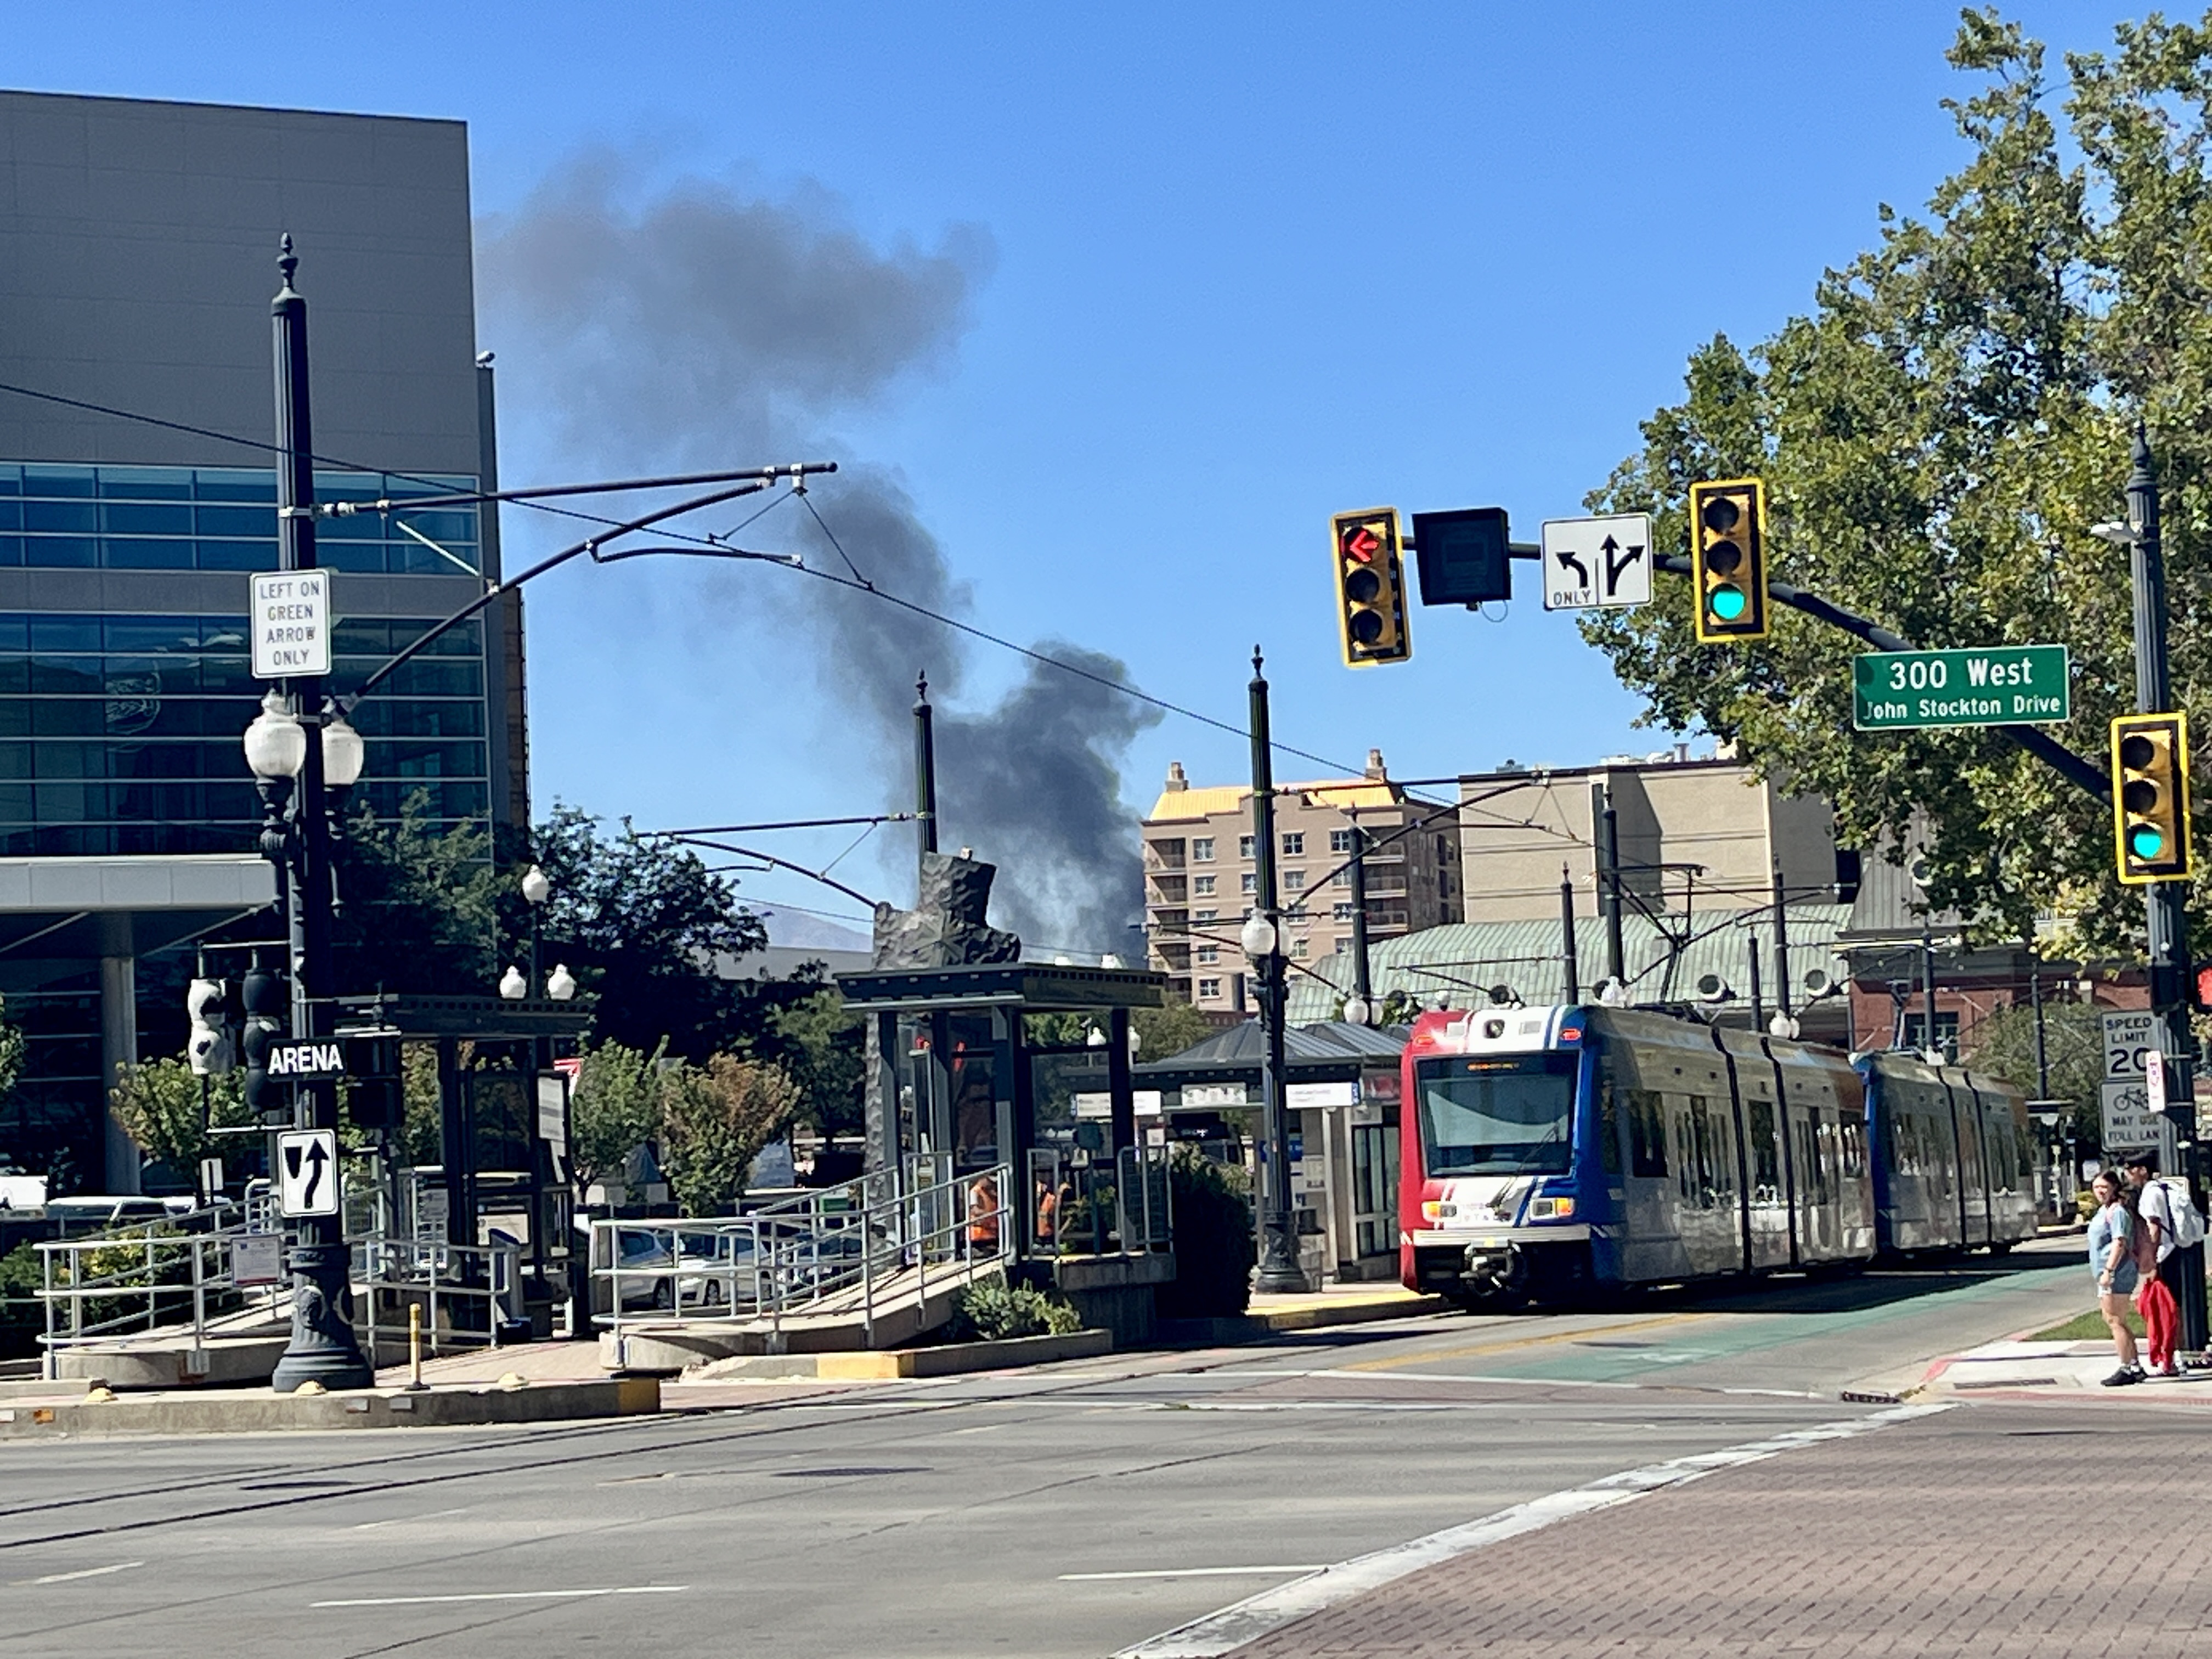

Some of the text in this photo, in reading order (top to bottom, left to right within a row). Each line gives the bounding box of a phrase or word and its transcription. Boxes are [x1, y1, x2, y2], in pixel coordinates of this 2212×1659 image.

[259, 580, 319, 600] LEFT ON
[1554, 590, 1591, 605] ONLY
[267, 604, 313, 620] GREEN
[266, 627, 316, 644] ARROW
[273, 650, 309, 665] ONLY
[1889, 656, 2033, 690] 300 West
[1863, 694, 2061, 720] John Stockton Drive
[2106, 1017, 2152, 1030] SPEED
[2111, 1032, 2147, 1043] LIMIT
[268, 1045, 343, 1075] ARENA
[2112, 1116, 2134, 1126] MAY
[2139, 1129, 2160, 1141] LAN
